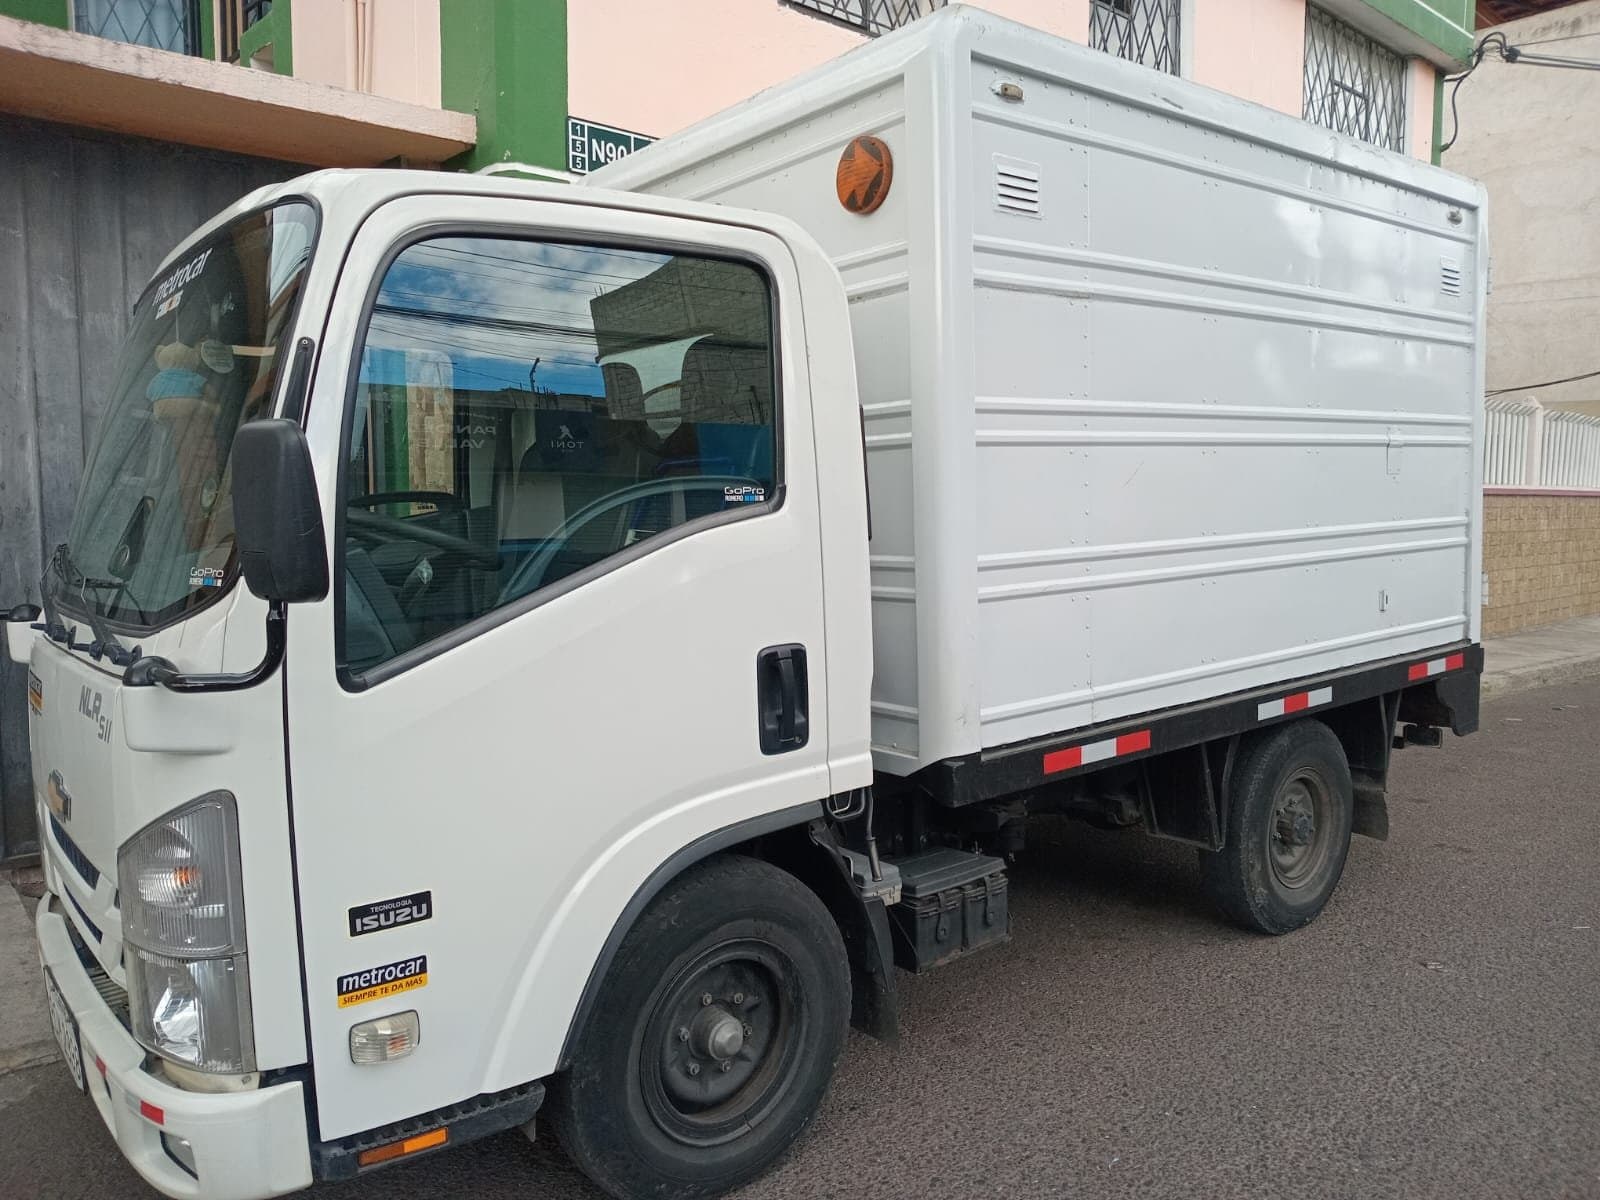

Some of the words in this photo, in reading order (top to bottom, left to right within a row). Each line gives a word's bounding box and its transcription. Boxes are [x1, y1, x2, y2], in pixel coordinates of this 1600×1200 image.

[152, 247, 213, 307] metrocar
[724, 486, 765, 495] GoPro
[190, 566, 224, 578] GoPro
[79, 684, 103, 723] NLR
[355, 903, 428, 932] ISUZU
[342, 958, 423, 992] metrocar
[342, 989, 378, 1005] SIEMPRE
[380, 985, 389, 994] TE
[391, 982, 404, 992] DA
[405, 976, 423, 988] MAS
